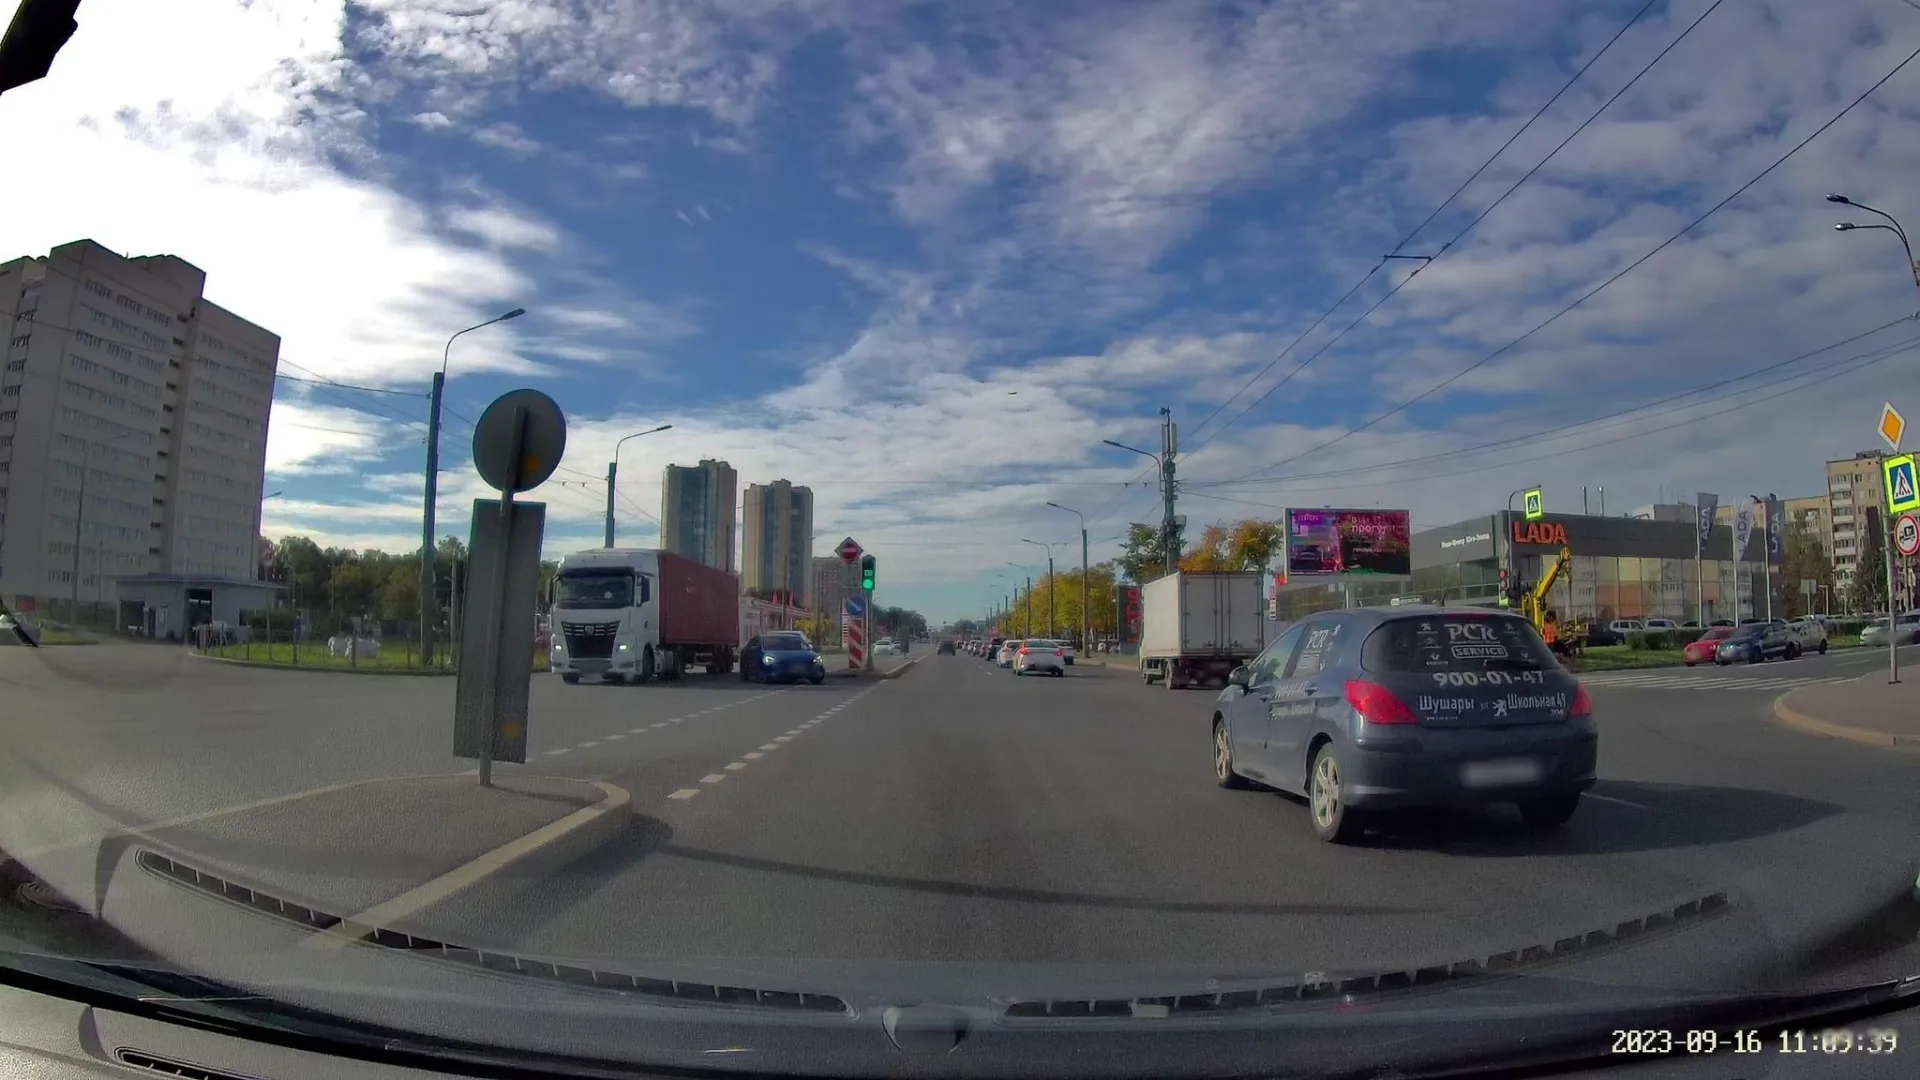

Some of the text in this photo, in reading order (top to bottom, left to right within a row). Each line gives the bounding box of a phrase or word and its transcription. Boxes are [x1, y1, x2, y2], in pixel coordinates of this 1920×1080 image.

[1514, 521, 1568, 544] LADA
[1454, 647, 1505, 656] SERVICE
[1432, 670, 1544, 687] 900-01-47
[1419, 695, 1474, 715] Шушары
[1507, 693, 1556, 710] Школьная
